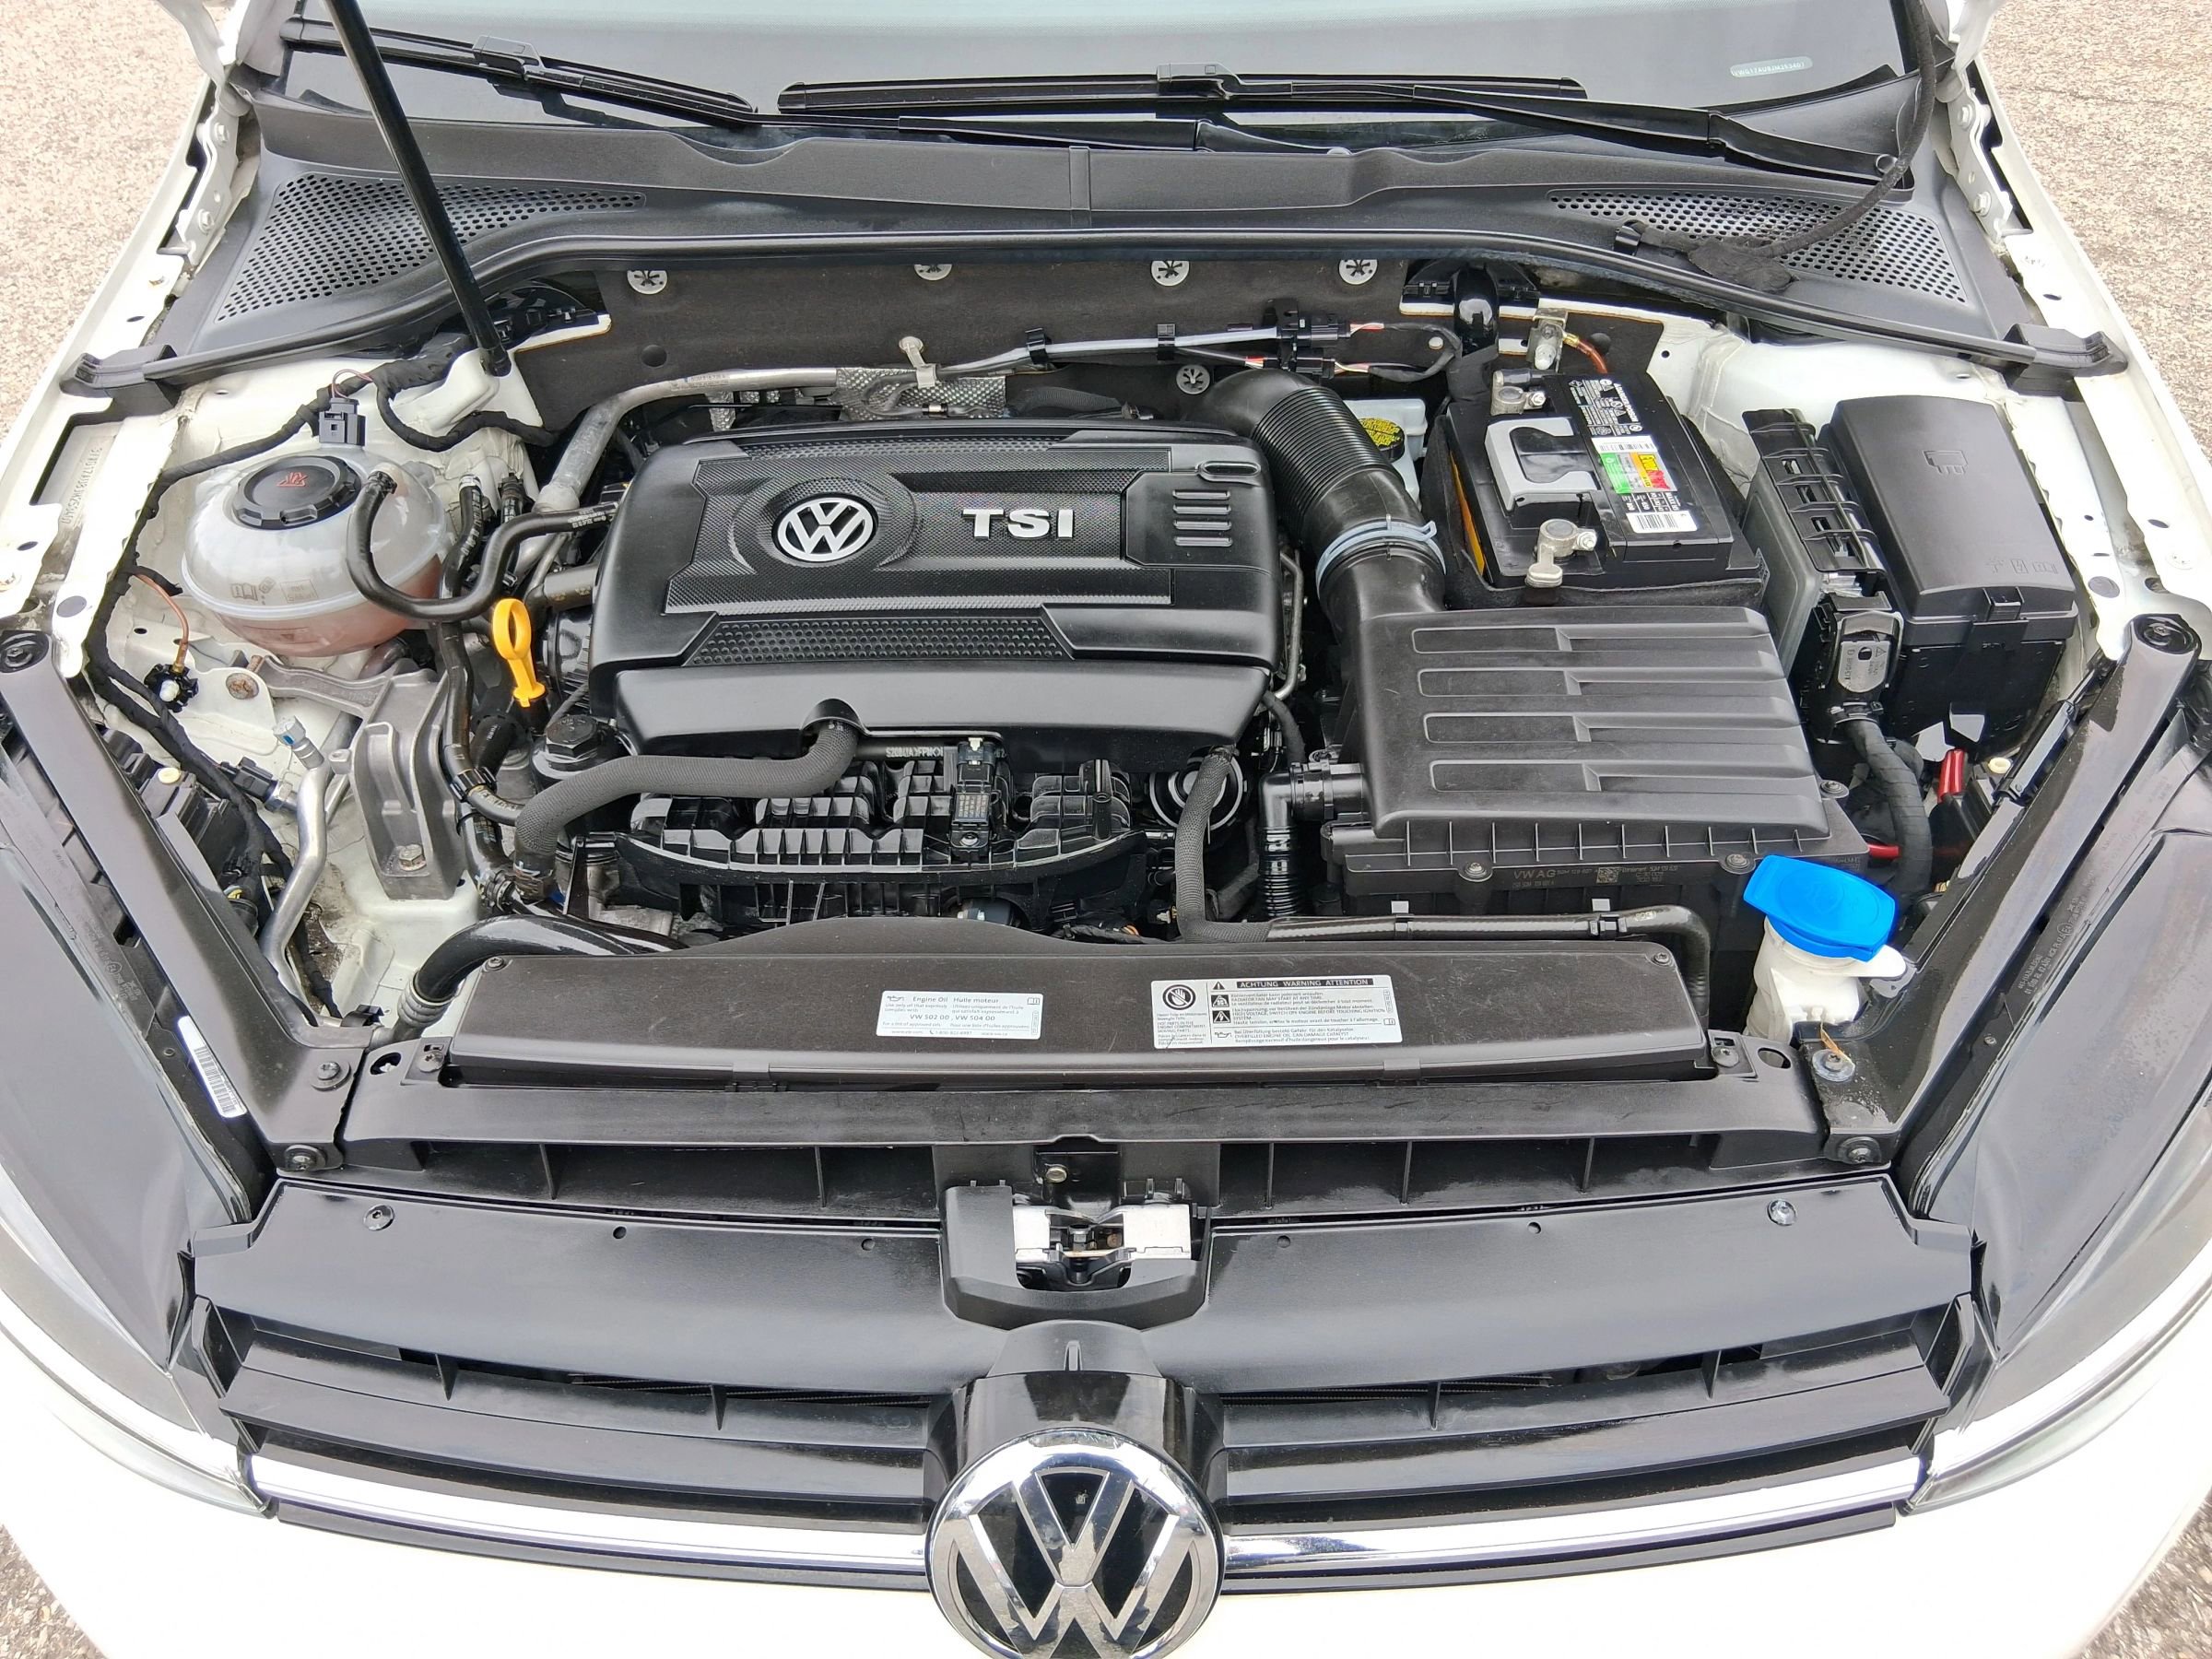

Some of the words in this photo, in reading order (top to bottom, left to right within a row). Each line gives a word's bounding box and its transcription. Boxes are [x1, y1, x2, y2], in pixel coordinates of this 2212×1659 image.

[777, 497, 874, 562] VW
[963, 509, 1074, 538] TSI
[1513, 870, 1535, 879] VW
[1535, 869, 1557, 878] AG
[930, 1428, 1219, 1658] VW
